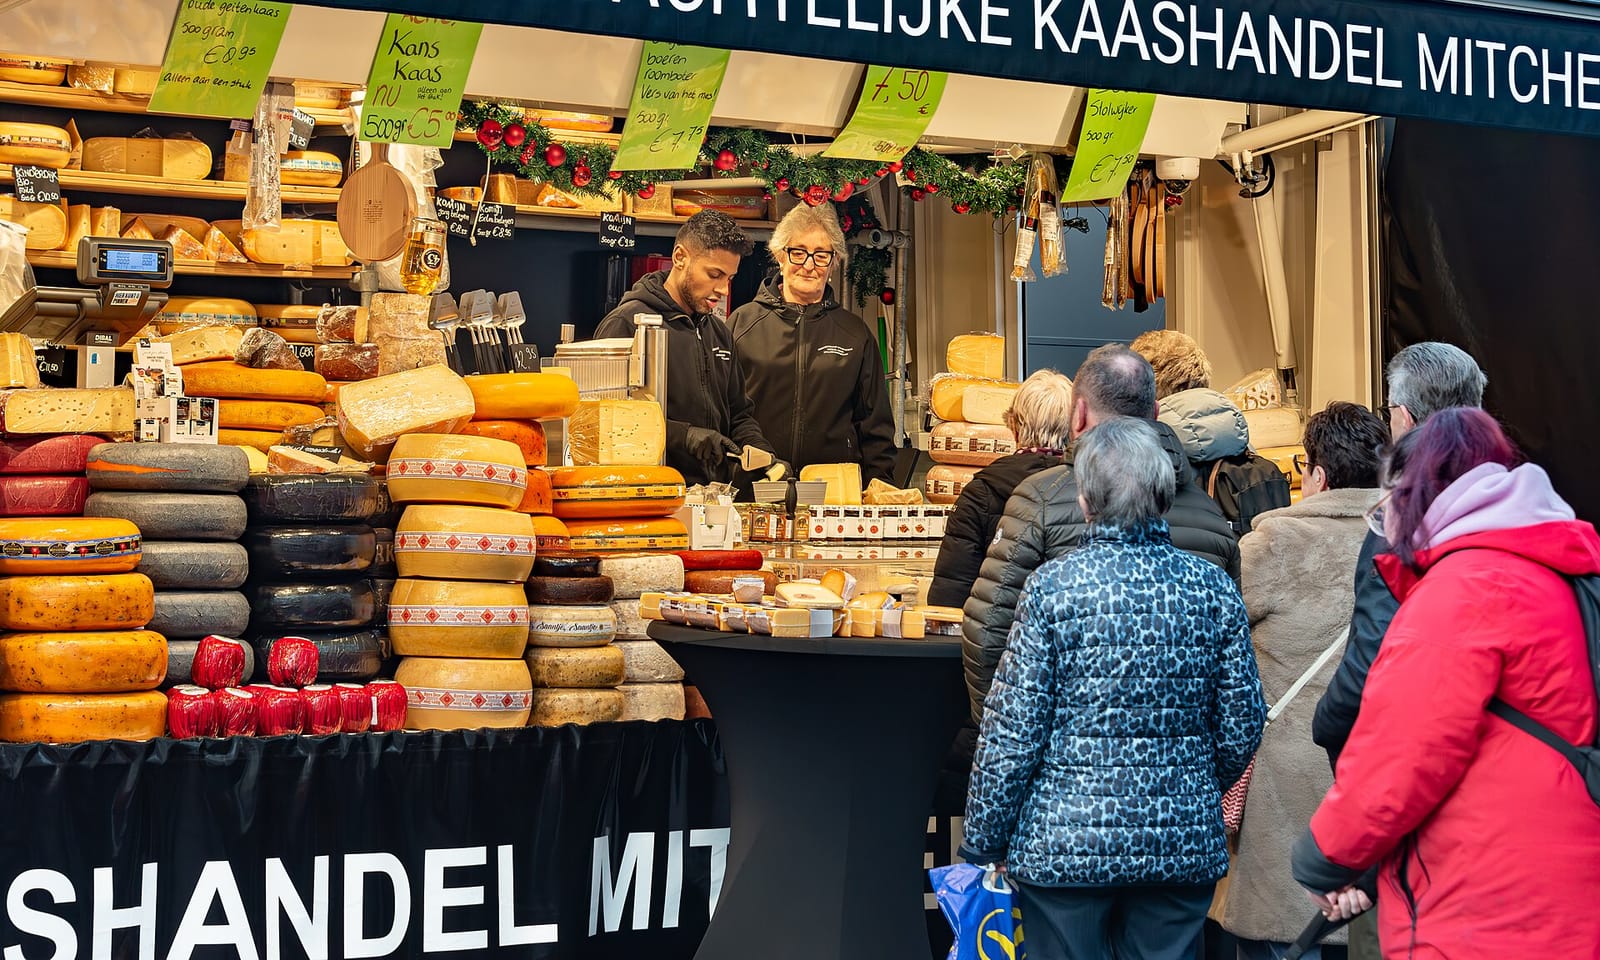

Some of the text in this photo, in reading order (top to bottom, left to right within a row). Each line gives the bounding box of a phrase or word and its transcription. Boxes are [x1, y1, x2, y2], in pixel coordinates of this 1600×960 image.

[388, 28, 441, 59] Kans
[647, 52, 687, 65] boeren
[1034, 0, 1403, 88] KAASHANDEL
[1417, 33, 1600, 110] MITCHE
[393, 59, 444, 84] Kaas
[643, 68, 697, 81] roomboter
[641, 84, 662, 99] Vers
[663, 92, 680, 100] van
[917, 103, 930, 115] €
[608, 224, 624, 234] oud
[94, 334, 113, 342] DIBAL
[3, 844, 559, 960] SHANDEL
